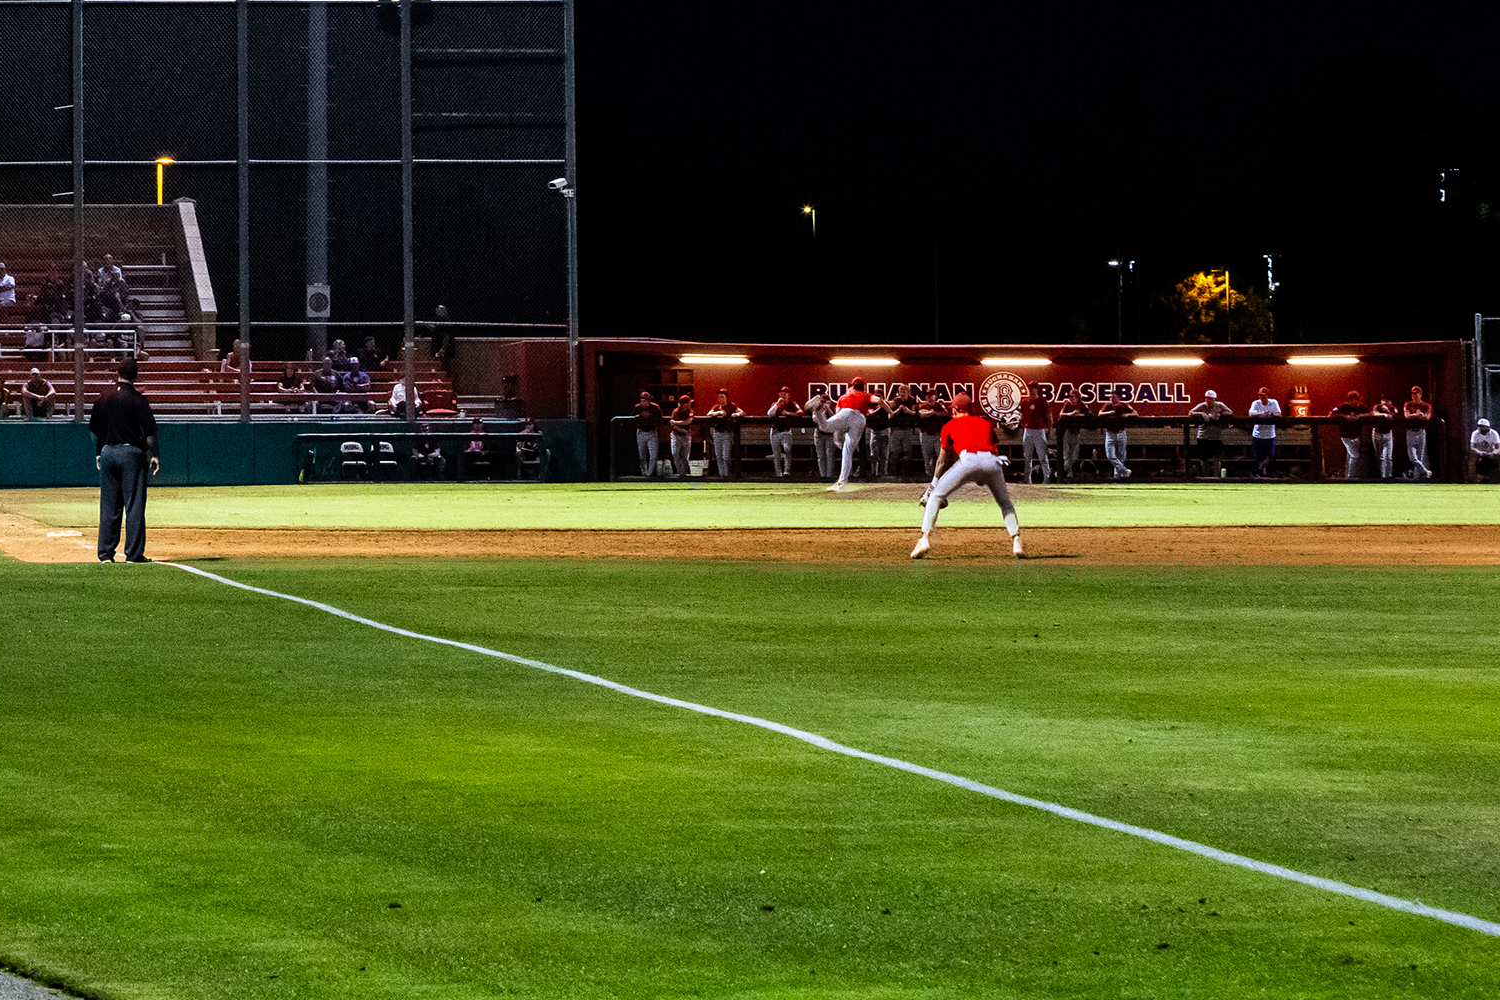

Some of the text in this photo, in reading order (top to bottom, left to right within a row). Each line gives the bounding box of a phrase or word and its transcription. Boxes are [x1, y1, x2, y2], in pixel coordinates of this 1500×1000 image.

[808, 382, 1191, 404] BUHANAN BASEBALL
[995, 382, 1015, 411] B
[1297, 407, 1306, 415] G
